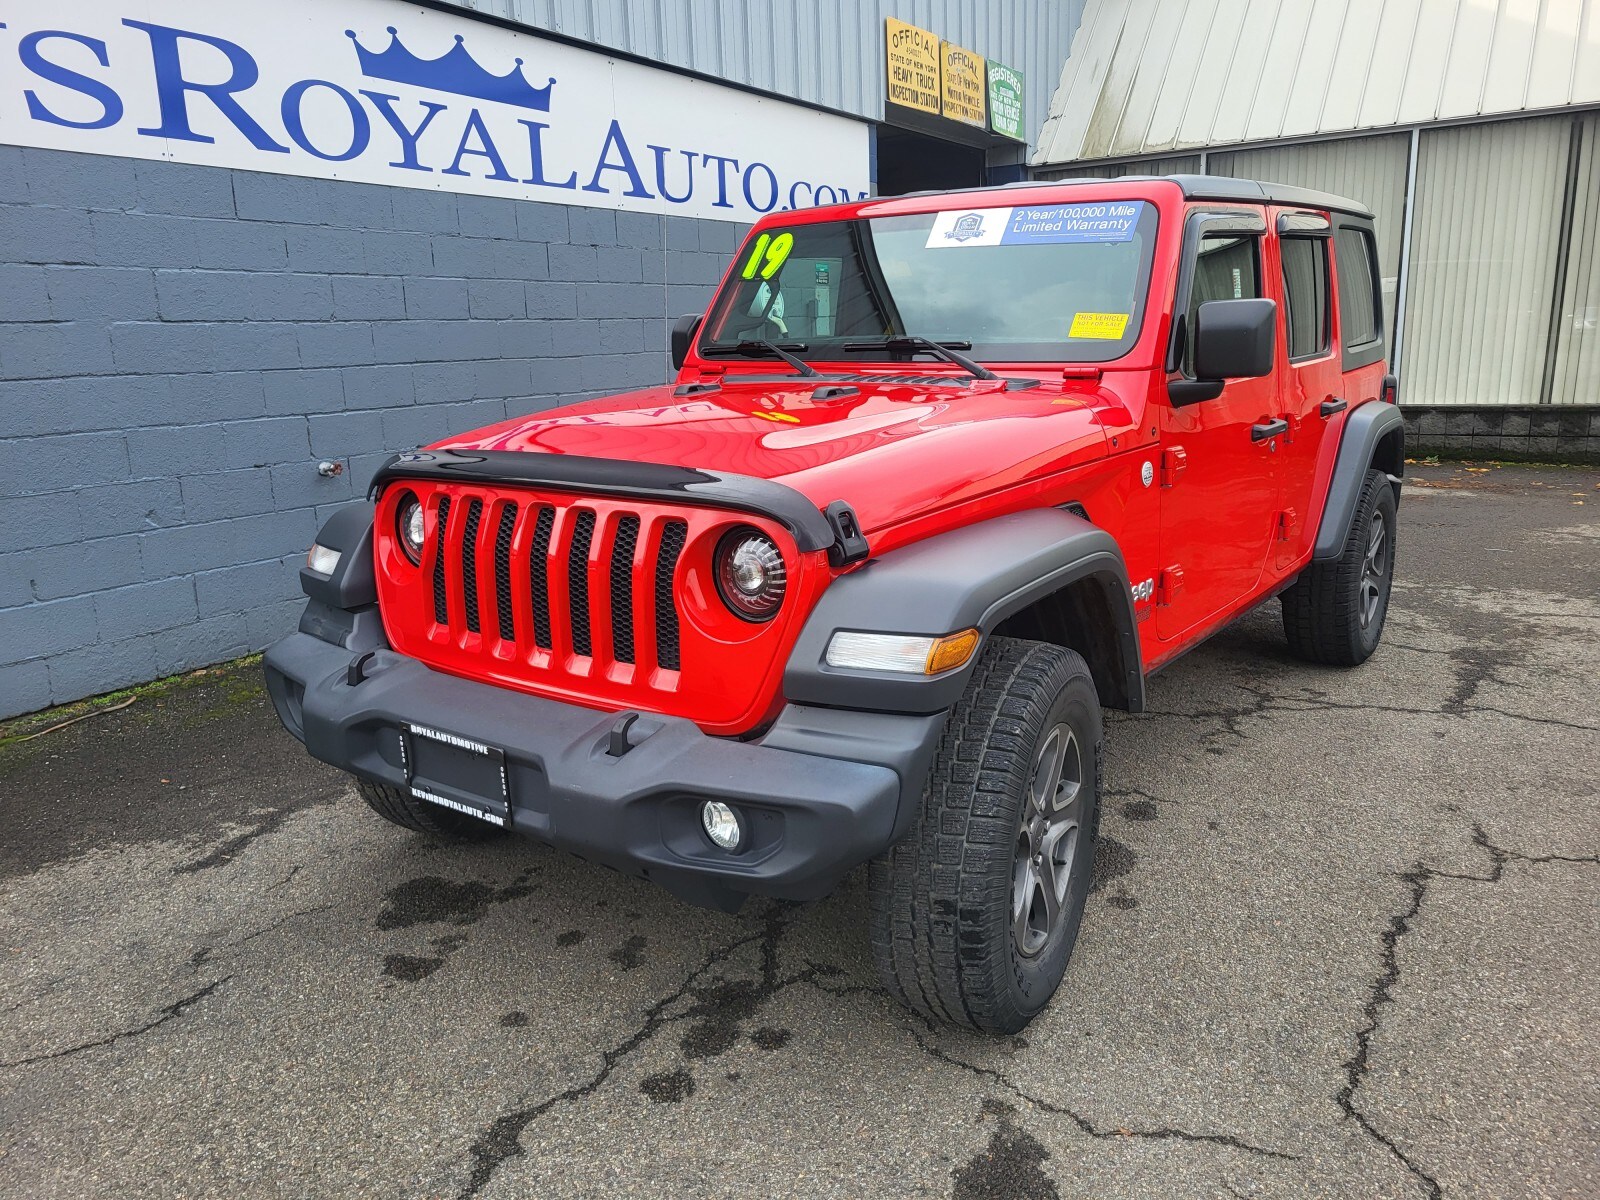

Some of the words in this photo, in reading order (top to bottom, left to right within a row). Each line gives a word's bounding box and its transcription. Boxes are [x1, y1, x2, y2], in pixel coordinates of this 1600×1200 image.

[892, 29, 935, 61] OFFICIAL
[891, 52, 904, 65] STATE
[906, 58, 912, 66] OF
[913, 60, 923, 70] NEW
[925, 64, 936, 74] YORK
[947, 51, 979, 80] OFFICIAL
[893, 65, 913, 84] HEAVY
[915, 72, 936, 91] TRUCK
[989, 67, 1021, 95] REGISTERED
[890, 83, 919, 105] INSPECTION
[920, 91, 939, 109] STATION
[943, 99, 969, 117] INSPECTION
[1013, 221, 1062, 233] Limited
[1066, 218, 1133, 231] Warranty
[1015, 210, 1025, 221] 2
[1026, 206, 1106, 221] Year/100,000
[1108, 205, 1136, 217] Mile
[742, 232, 794, 280] 19
[1130, 577, 1154, 602] eep
